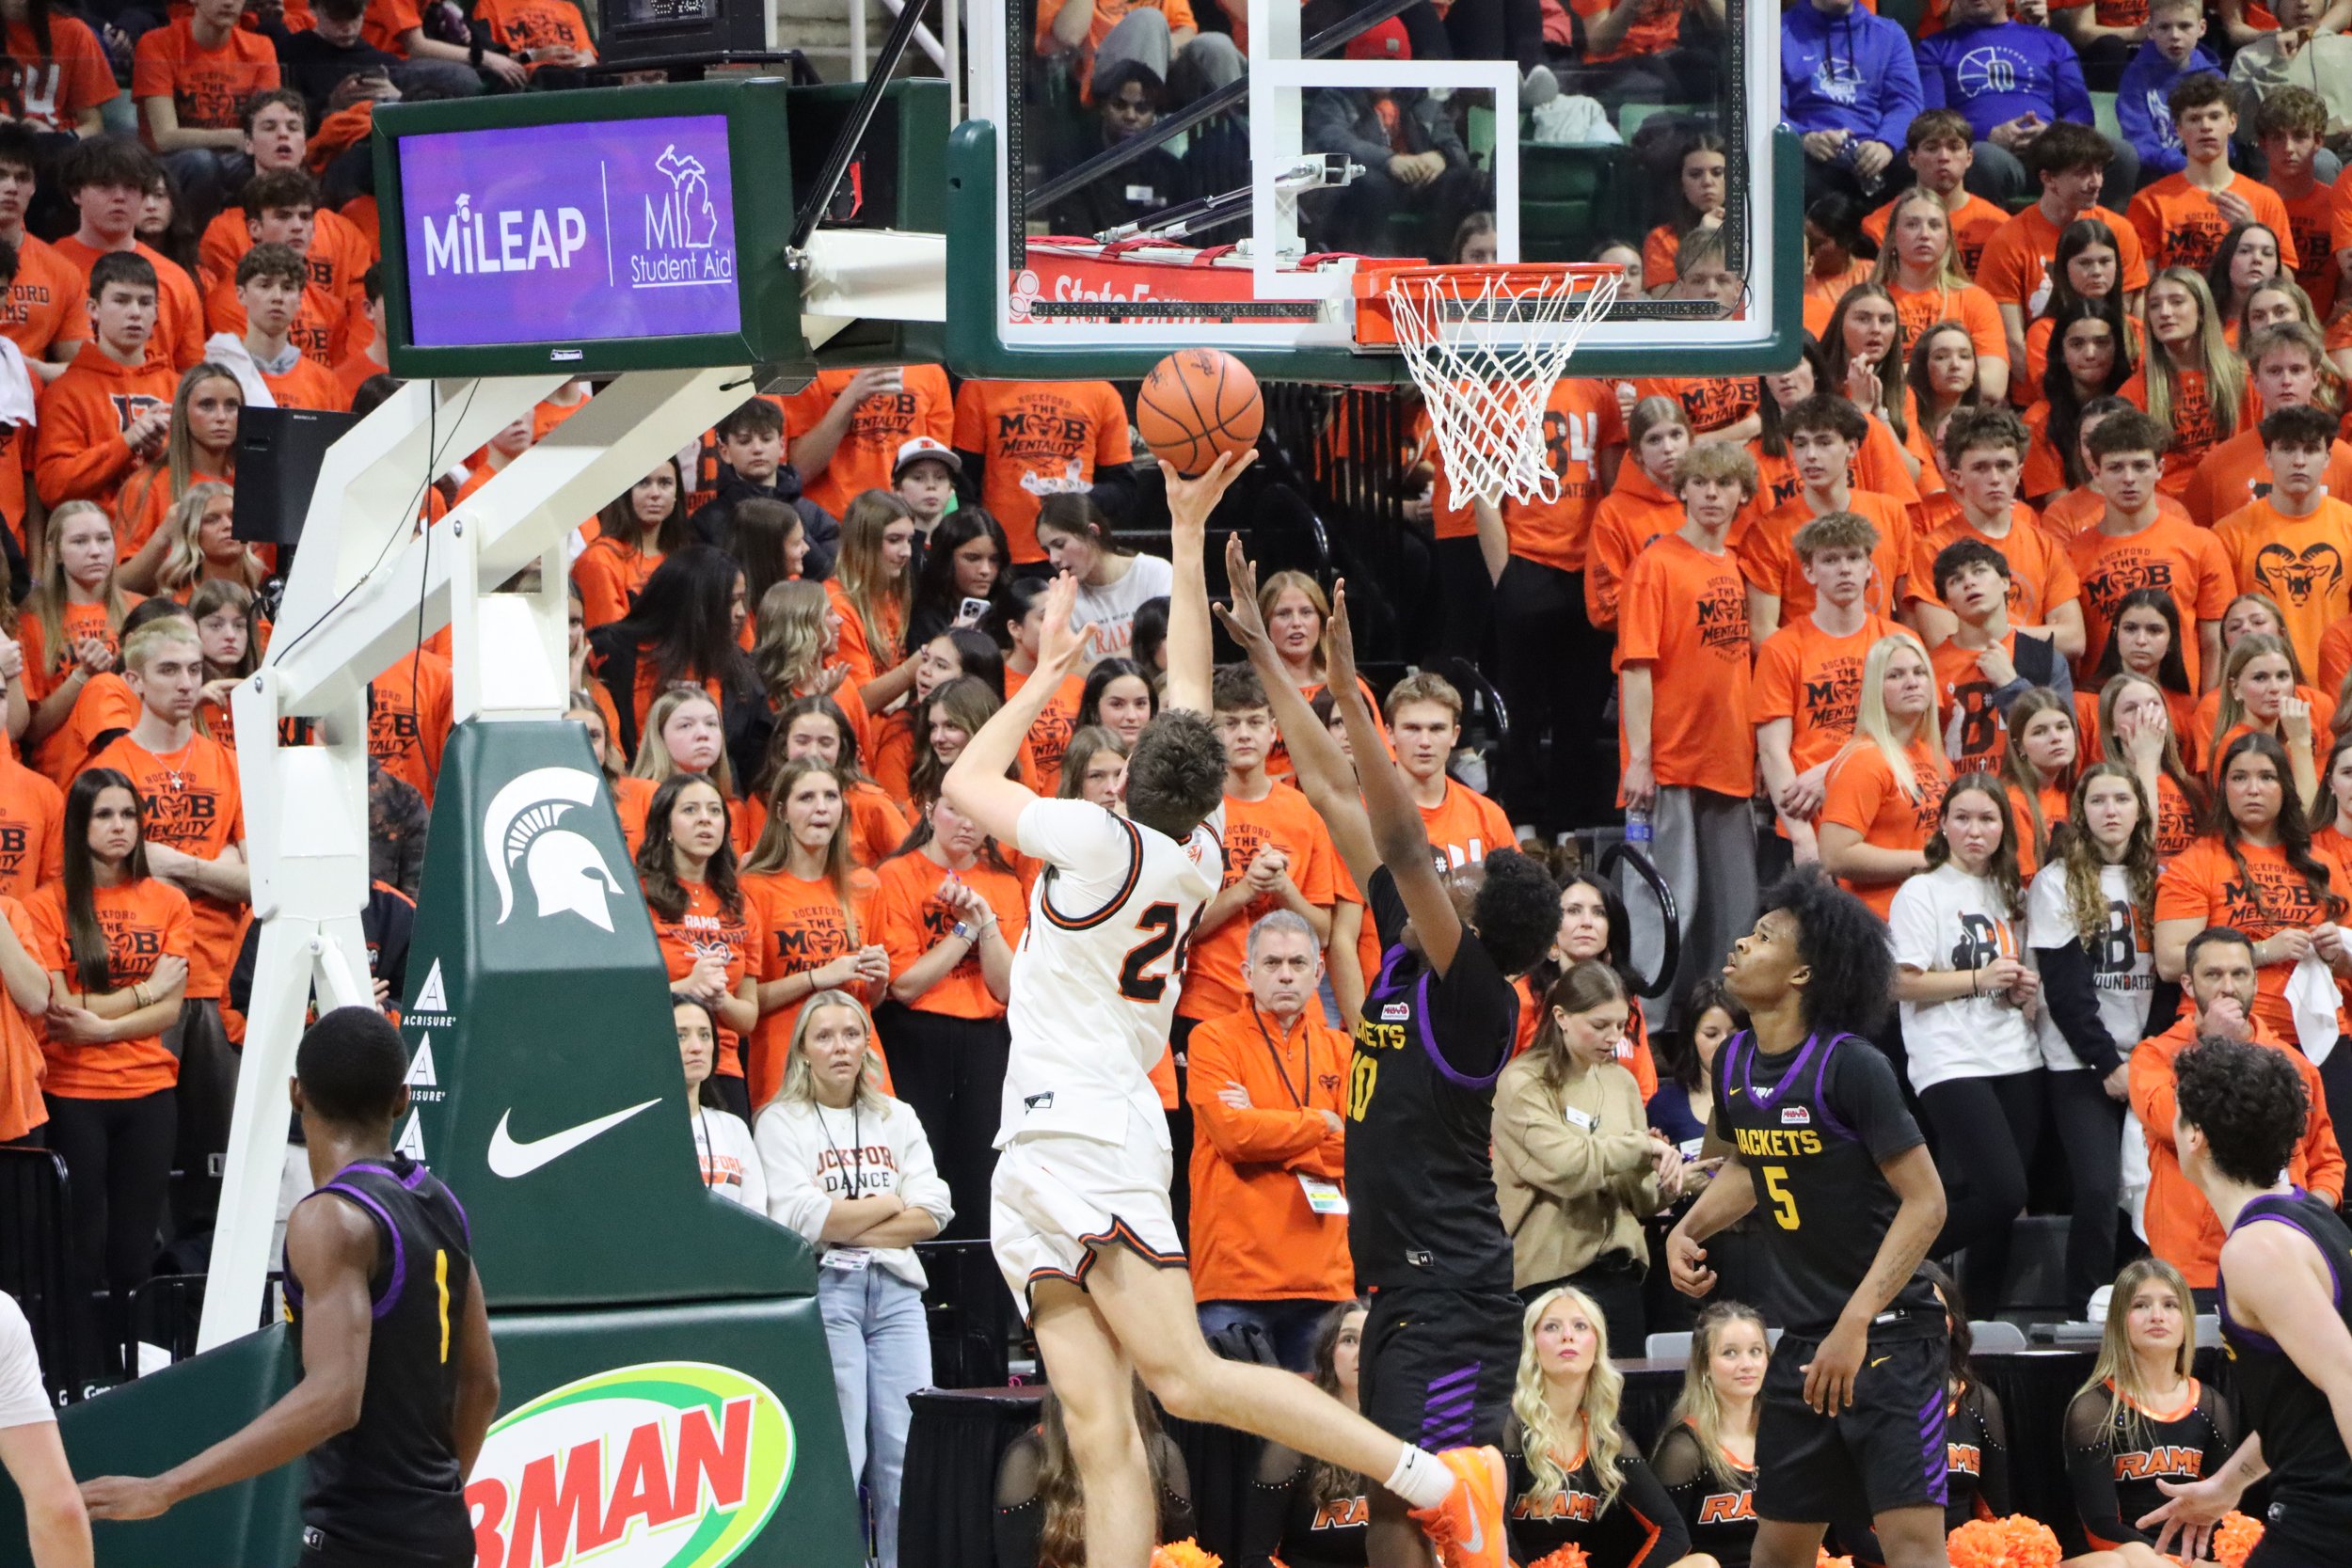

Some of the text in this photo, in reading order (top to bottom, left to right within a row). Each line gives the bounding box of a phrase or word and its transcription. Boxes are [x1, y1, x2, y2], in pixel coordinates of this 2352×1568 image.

[424, 205, 587, 276] MiLEAP
[631, 249, 732, 283] Student Aid
[1031, 404, 1057, 417] THE
[2112, 557, 2139, 568] THE
[1716, 587, 1737, 598] THE
[1835, 668, 1858, 679] THE
[1233, 836, 1258, 847] THE
[2256, 874, 2283, 884] THE
[684, 914, 721, 930] RAMS
[807, 918, 834, 928] THE
[825, 1172, 890, 1193] DANCE
[1762, 1165, 1801, 1230] 5
